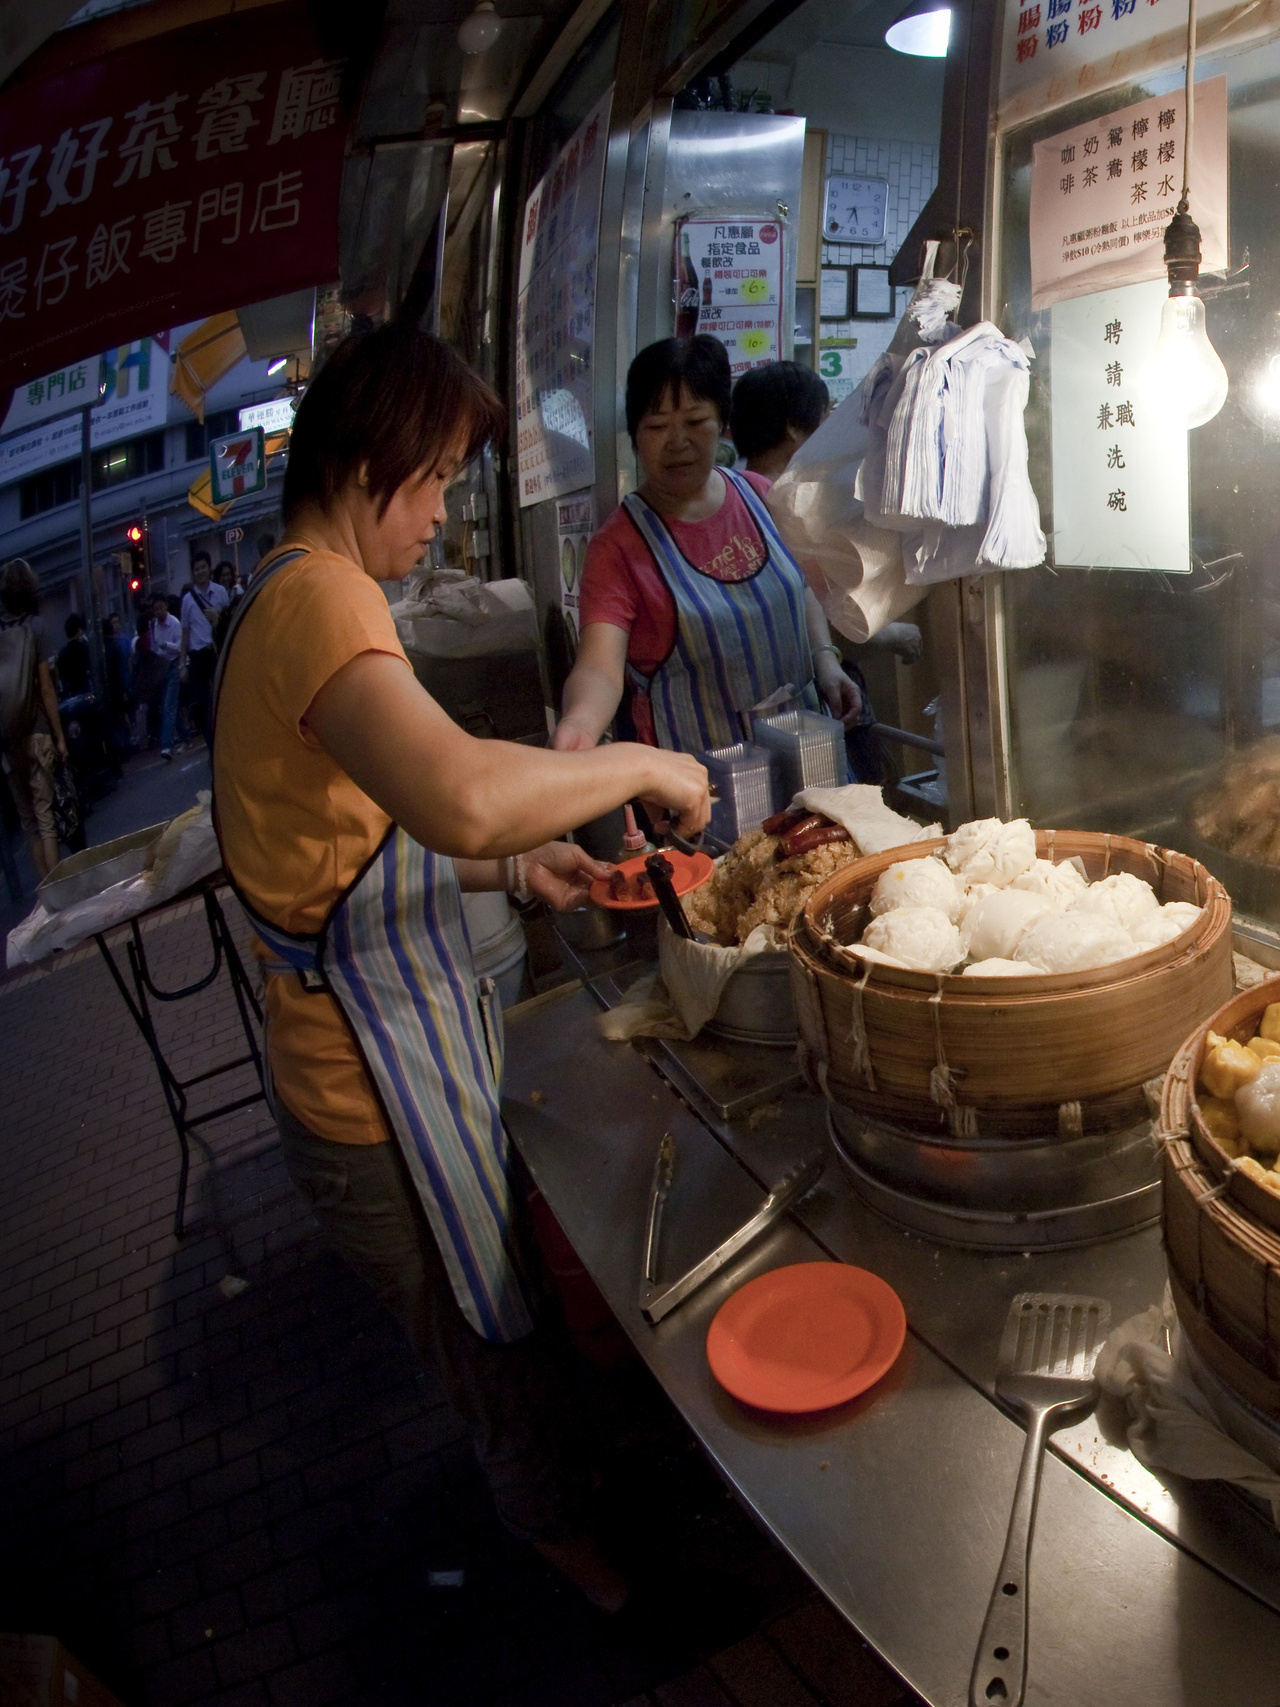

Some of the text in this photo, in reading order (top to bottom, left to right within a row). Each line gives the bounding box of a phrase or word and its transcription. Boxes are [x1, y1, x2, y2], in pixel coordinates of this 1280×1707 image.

[1016, 0, 1041, 63] 腸粉
[1060, 144, 1075, 195] 咖啡
[1082, 136, 1100, 189] 奶茶
[1106, 126, 1123, 181] 鴛鴦
[1130, 117, 1150, 205] 檸檬茶
[1157, 108, 1177, 197] 檸檬水
[708, 242, 760, 256] 指定食品
[714, 226, 753, 239] 凡惠顧
[1062, 220, 1118, 247] 凡惠顧粥粉麵飯
[700, 308, 722, 319] 或改
[26, 365, 88, 406] 專門店
[820, 351, 843, 378] 3
